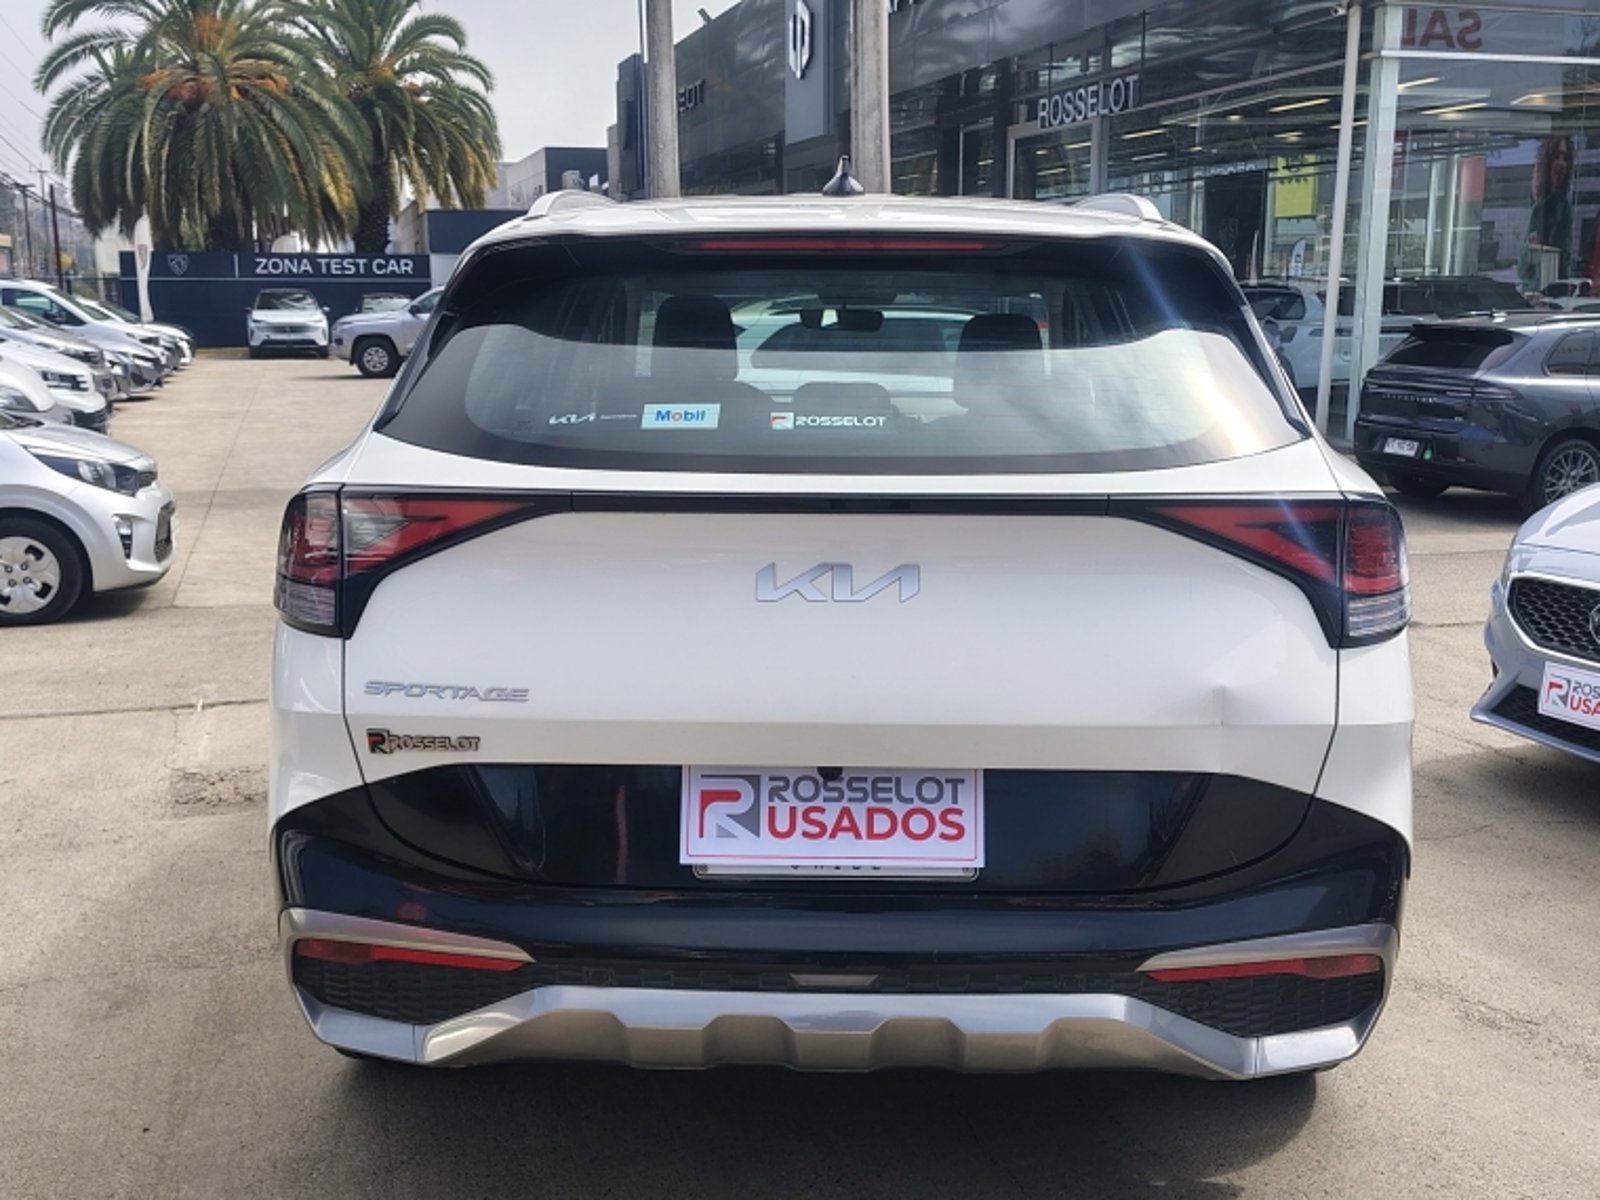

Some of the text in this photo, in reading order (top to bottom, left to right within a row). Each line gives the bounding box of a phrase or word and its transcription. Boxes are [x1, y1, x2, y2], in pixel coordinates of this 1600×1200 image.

[1037, 74, 1139, 129] ROSSELOT
[255, 258, 413, 275] ZONA TEST CAR
[655, 409, 706, 422] Mobil
[795, 415, 887, 427] ROSSELOT
[756, 561, 921, 603] KIA
[364, 680, 529, 702] SPORTAGE
[390, 733, 481, 753] ROSSELOT
[767, 775, 965, 805] ROSSELOT
[767, 805, 965, 842] USADOS
